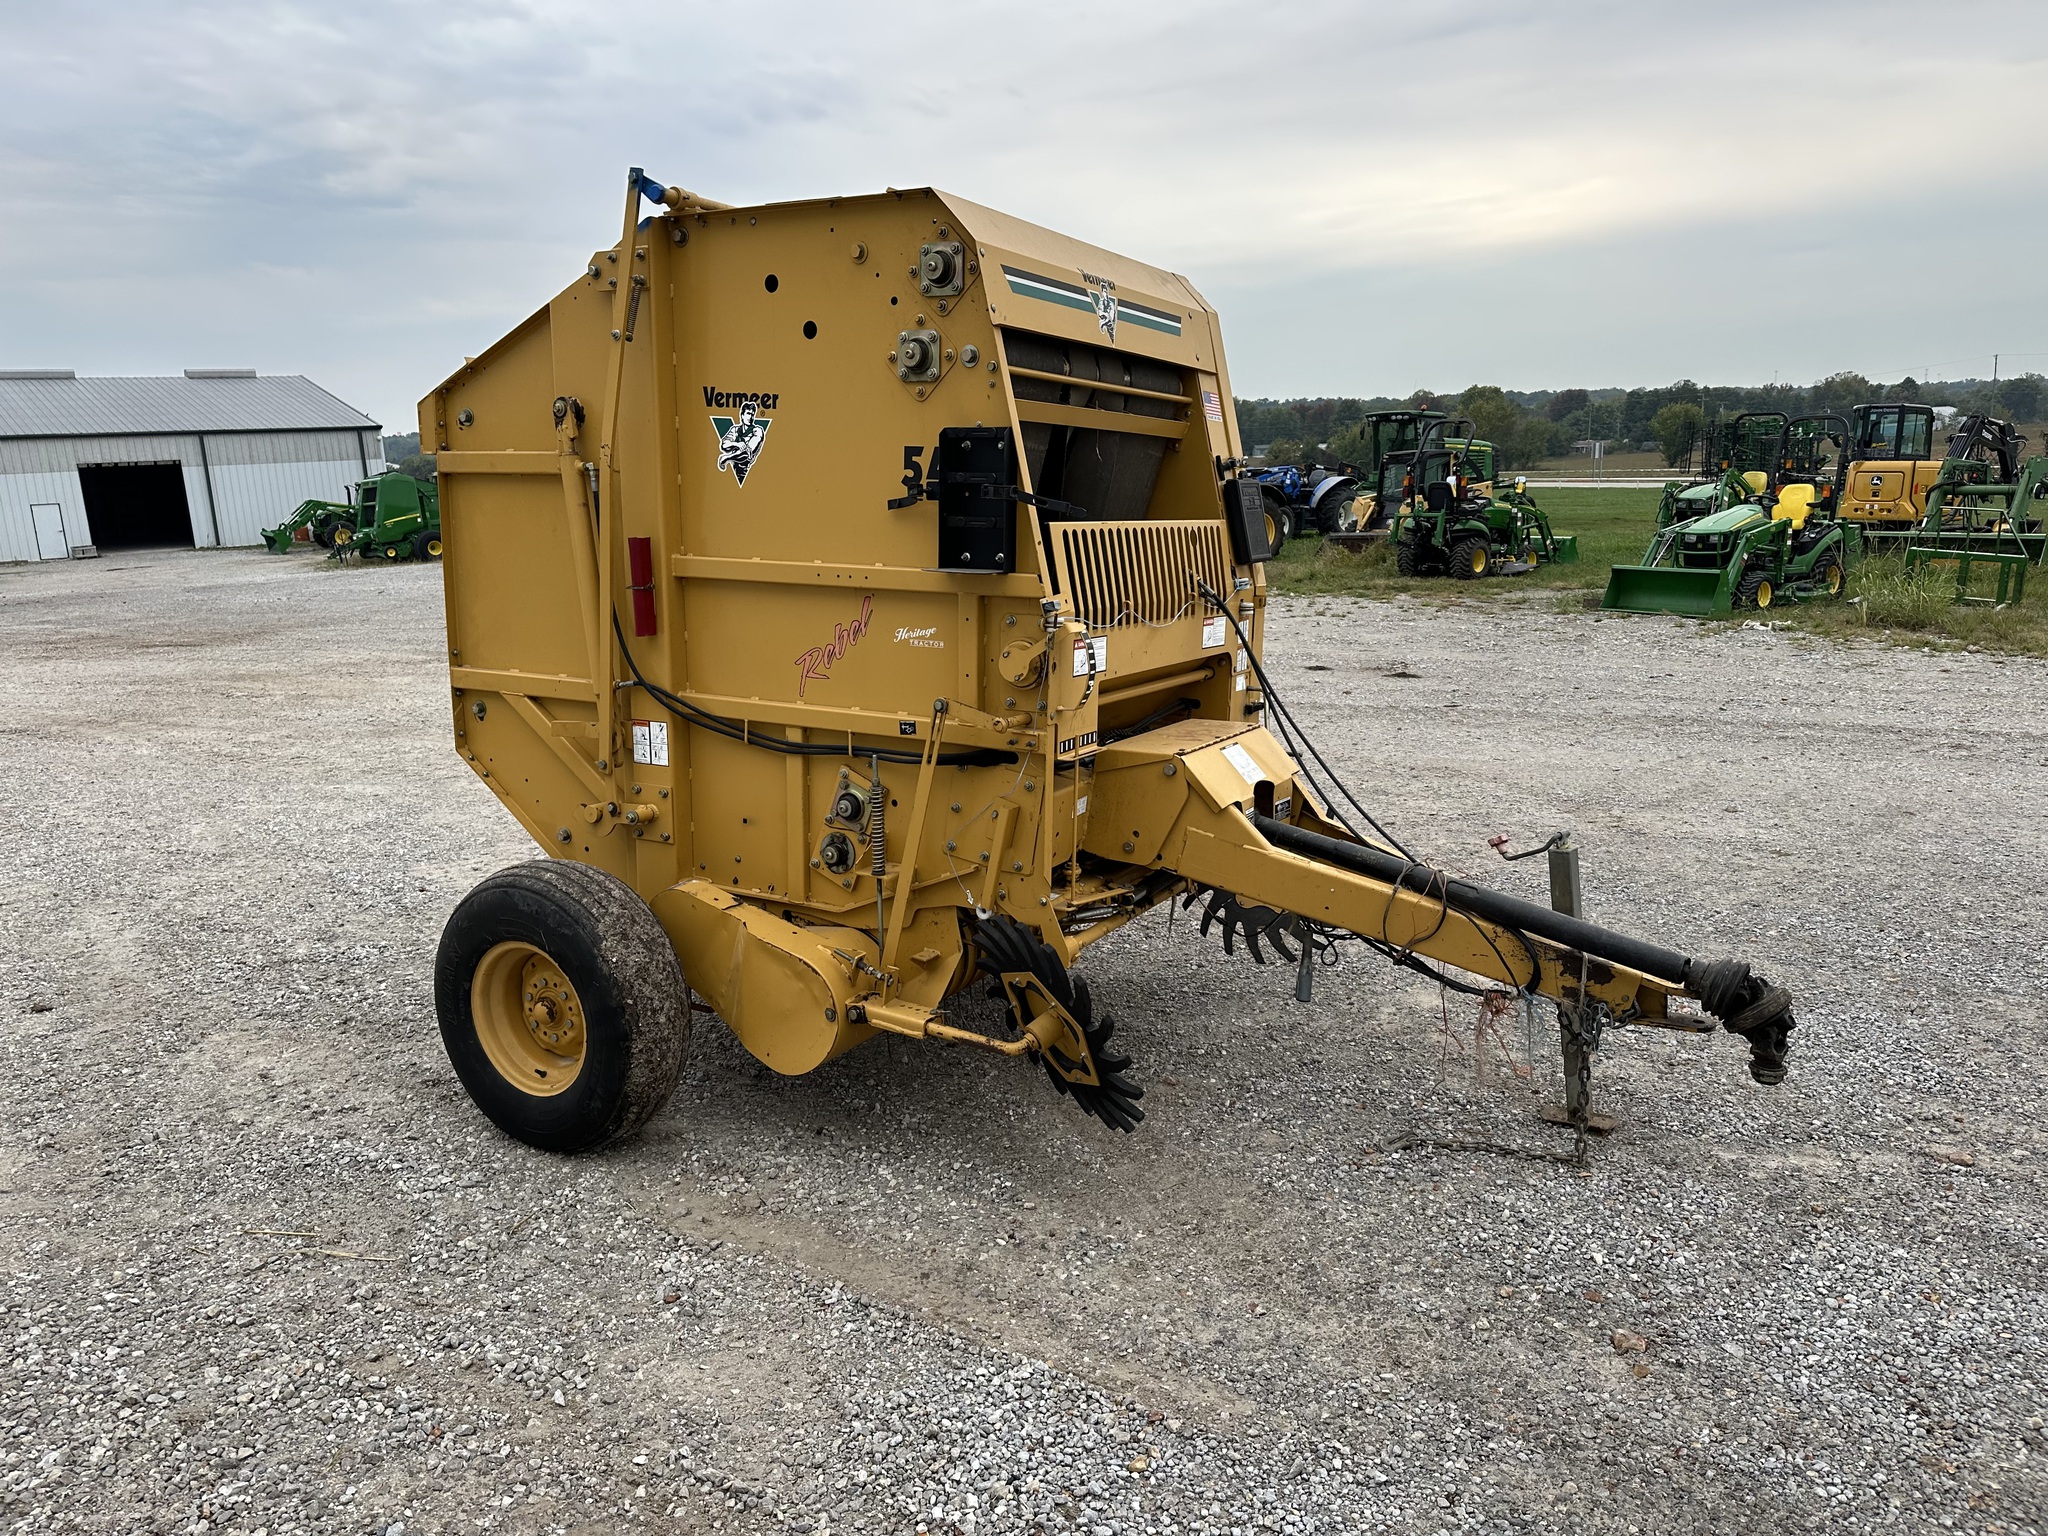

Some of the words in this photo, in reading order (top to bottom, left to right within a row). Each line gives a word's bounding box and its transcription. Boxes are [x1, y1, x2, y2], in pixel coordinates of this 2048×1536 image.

[703, 386, 779, 410] Vermeer
[893, 627, 937, 643] Heritage
[909, 639, 945, 648] TRACTOR
[795, 596, 873, 698] Rebel
